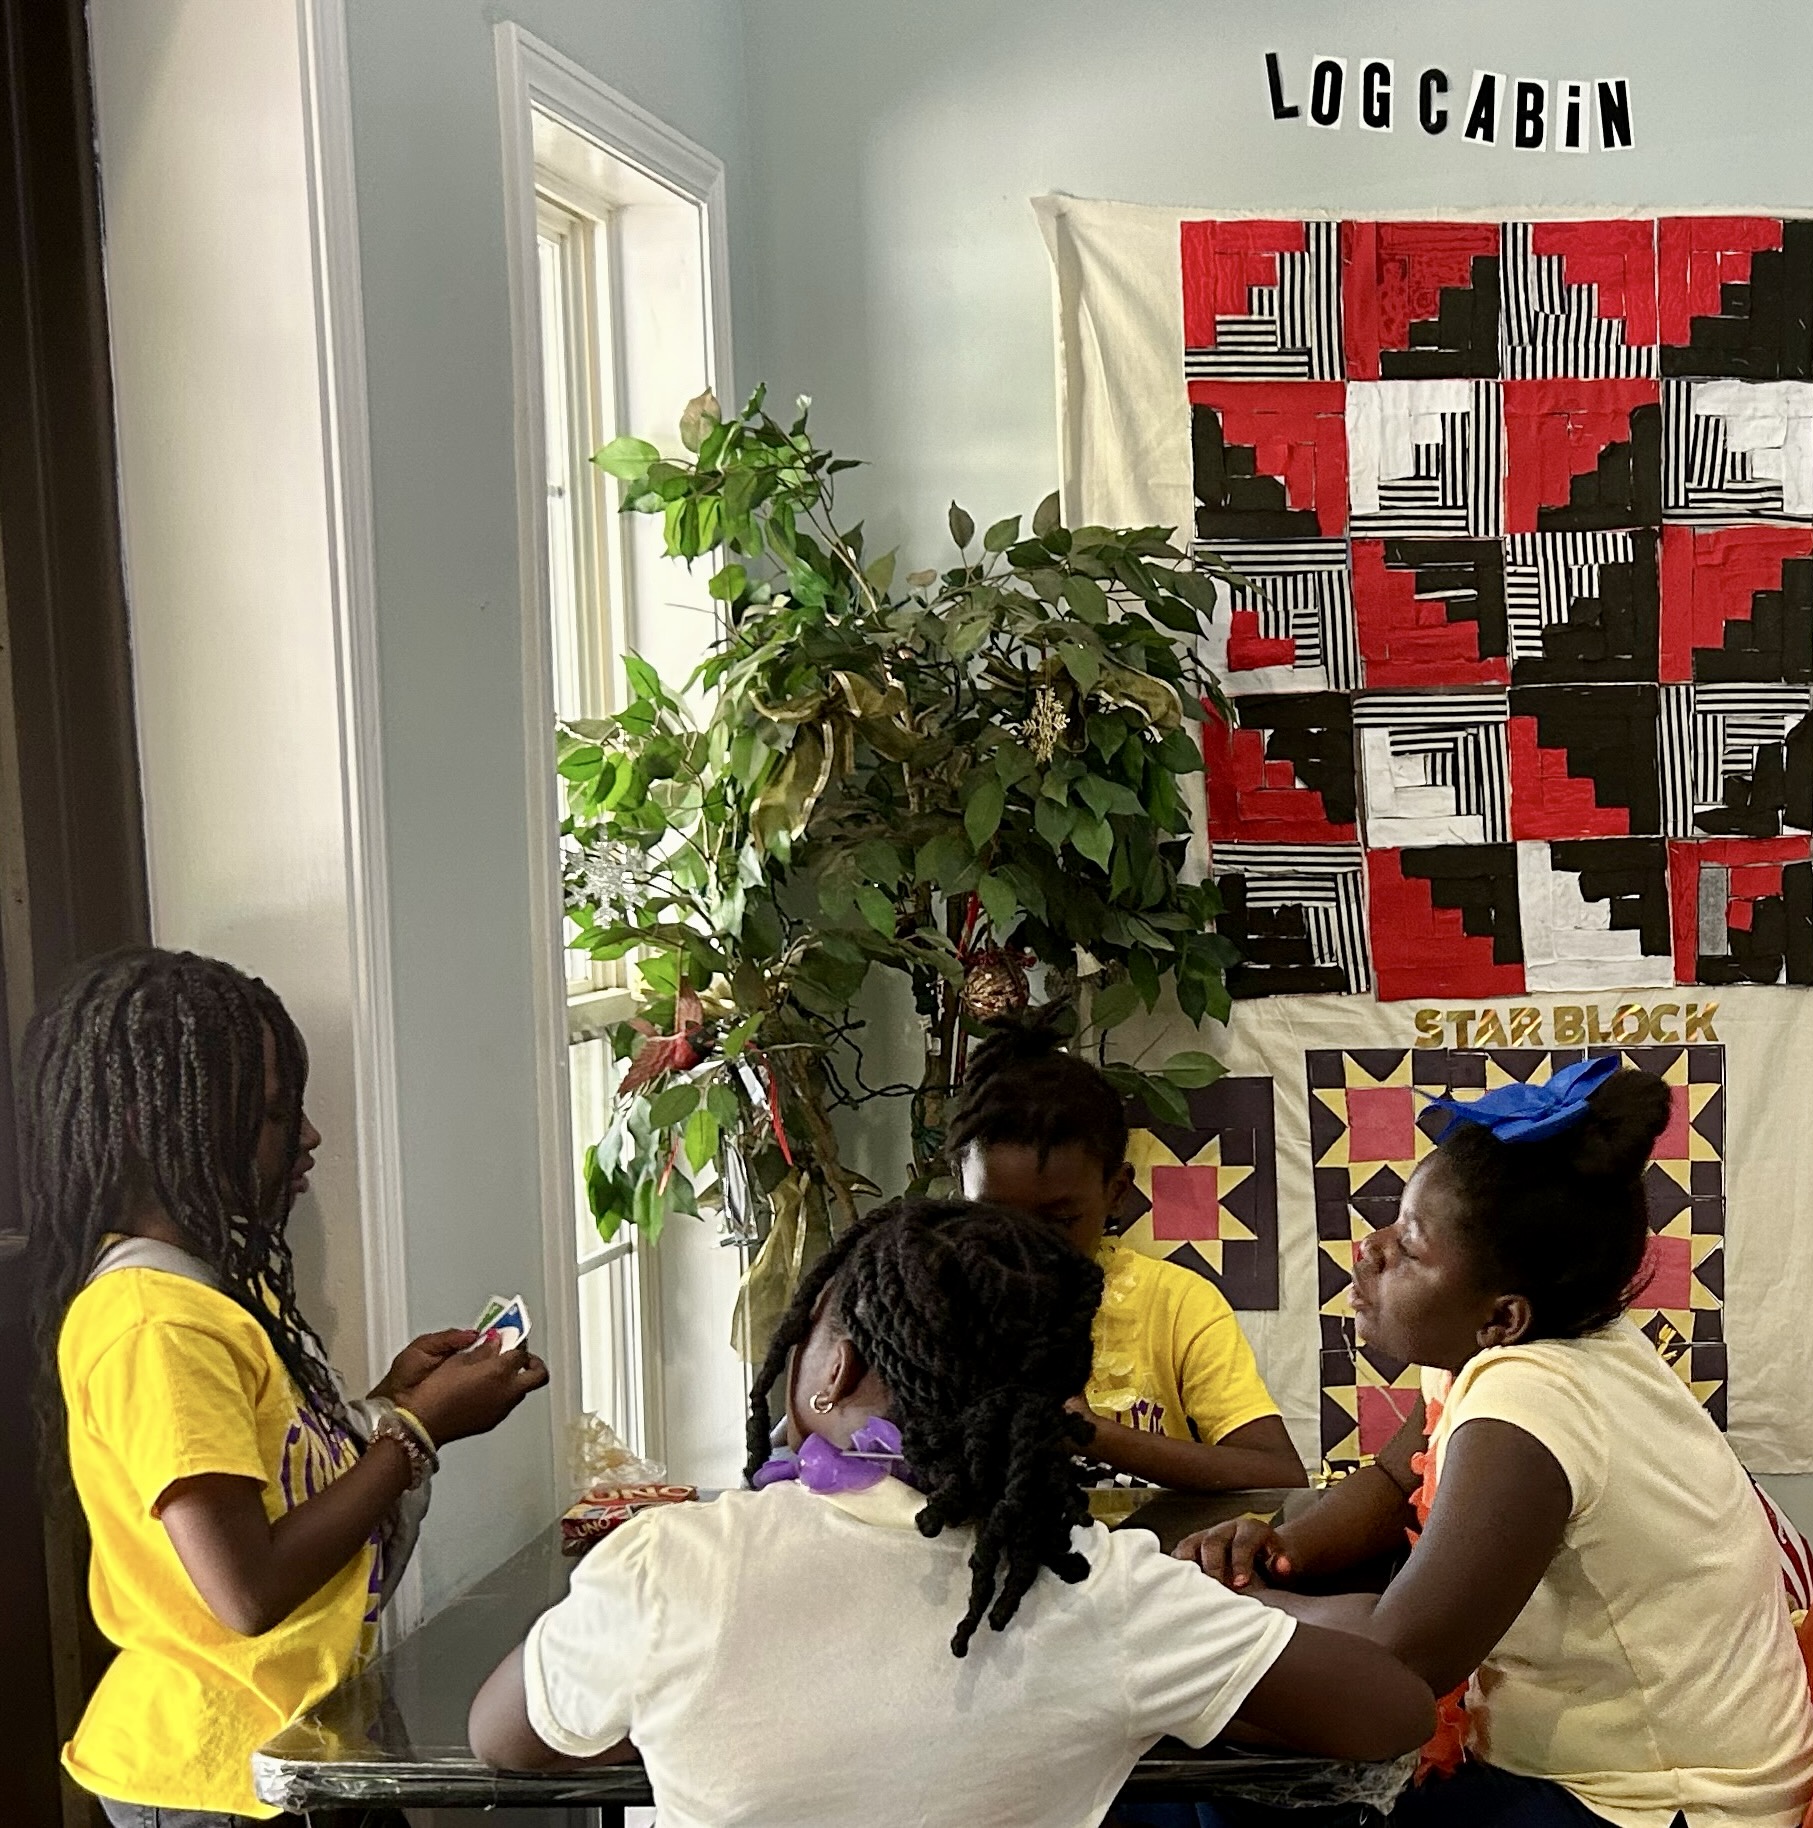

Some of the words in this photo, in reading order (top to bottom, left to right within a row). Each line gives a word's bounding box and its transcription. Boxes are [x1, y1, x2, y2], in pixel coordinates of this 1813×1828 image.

[1264, 52, 1392, 128] LOG
[1414, 1006, 1544, 1048] STAR
[1553, 1003, 1719, 1045] BLOCK
[585, 1486, 696, 1502] UNO
[576, 1518, 611, 1537] UNO
